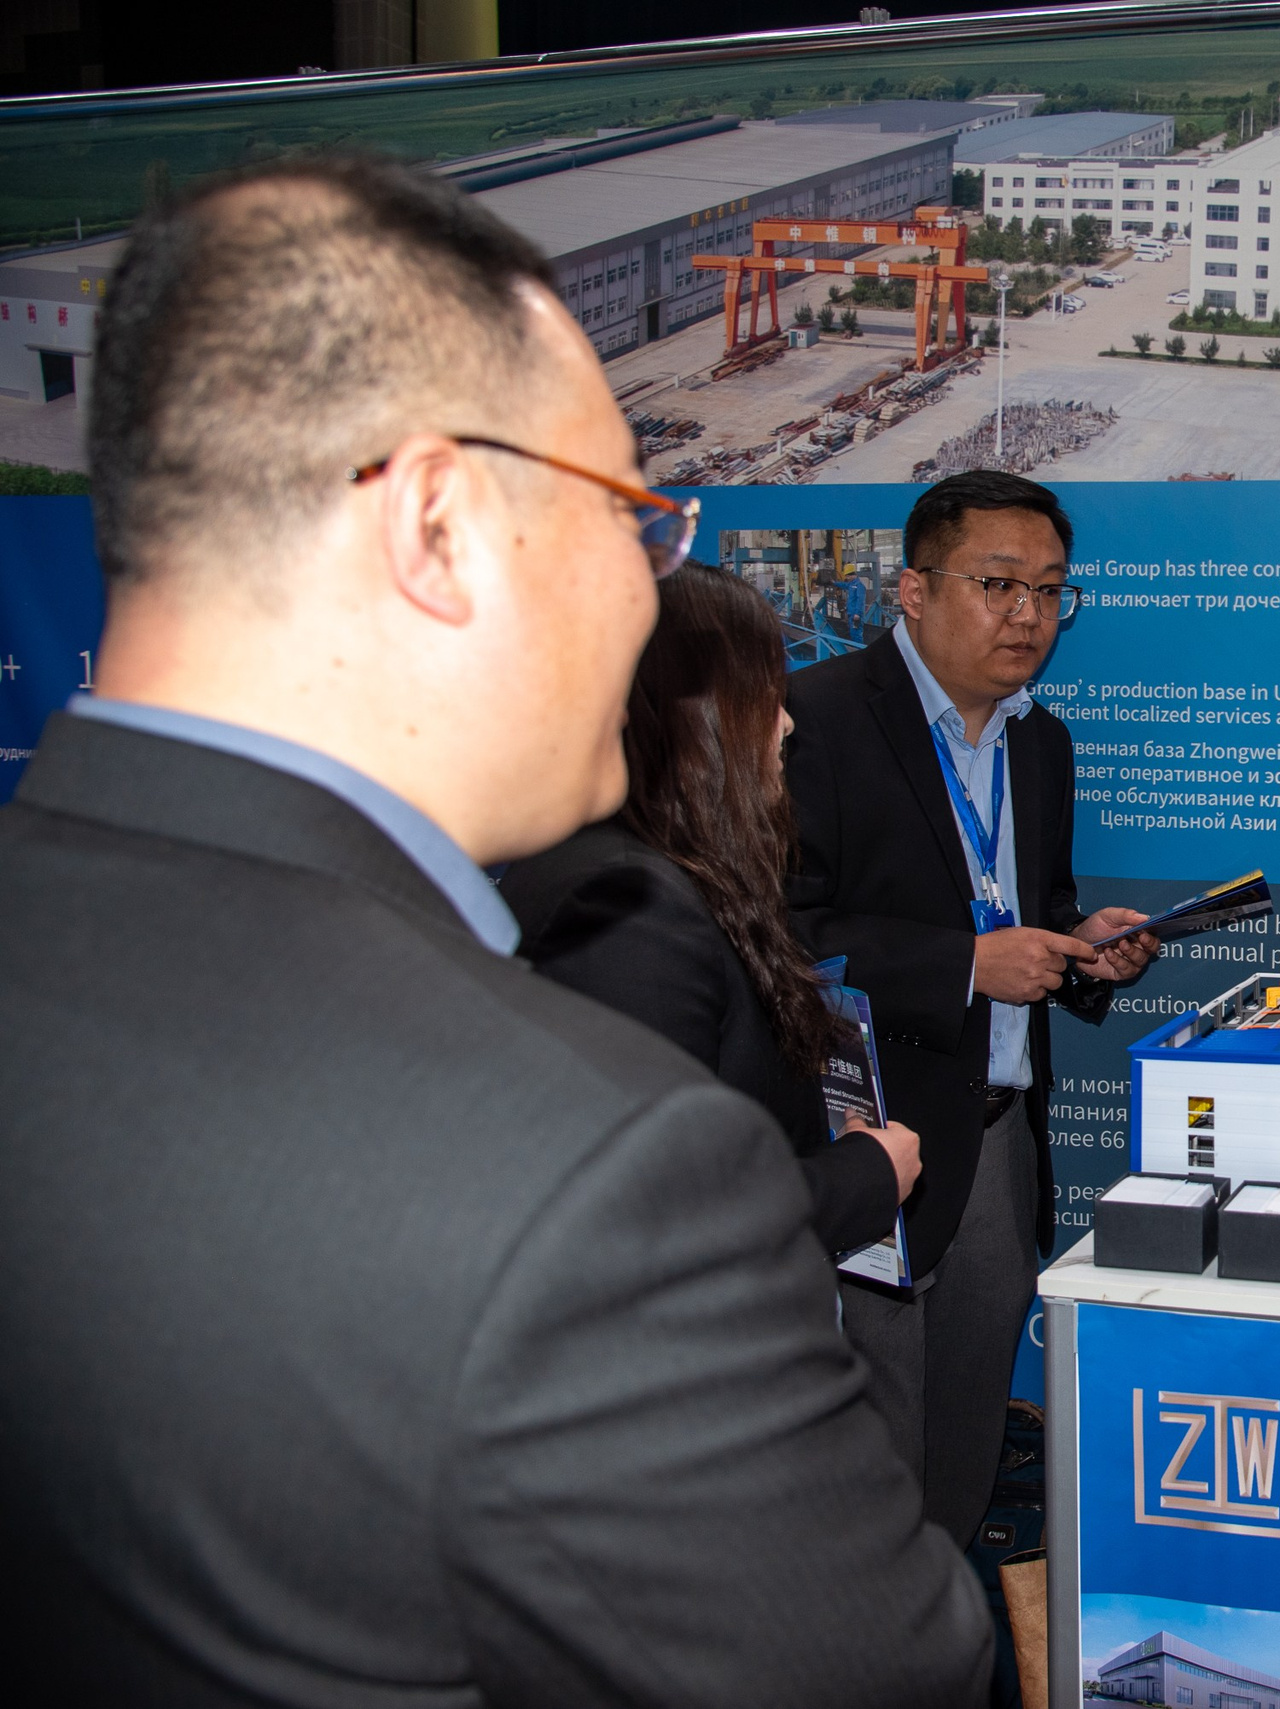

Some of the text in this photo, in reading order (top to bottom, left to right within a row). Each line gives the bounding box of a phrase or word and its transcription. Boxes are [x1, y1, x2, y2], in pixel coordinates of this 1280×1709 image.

[1066, 560, 1101, 578] wei
[1105, 560, 1161, 581] Group
[1165, 559, 1196, 577] has
[1200, 559, 1249, 577] three
[1080, 590, 1097, 607] ei
[1101, 594, 1191, 609] включает
[1195, 594, 1229, 612] три
[1101, 681, 1198, 701] production
[1202, 682, 1246, 700] base
[1251, 683, 1269, 701] in
[1048, 703, 1109, 721] fficient
[1114, 704, 1191, 723] localized
[1195, 707, 1271, 724] services
[1073, 742, 1139, 757] венная
[1143, 740, 1185, 759] база
[1075, 765, 1115, 779] вает
[1120, 766, 1243, 785] оперативное
[1248, 770, 1259, 783] и
[1116, 787, 1255, 809] обслуживание
[1100, 809, 1277, 832] Центральной Азии
[1227, 914, 1268, 934] and
[1156, 943, 1183, 959] an
[1190, 943, 1265, 963] annual
[1108, 995, 1200, 1015] xecution
[1062, 1078, 1075, 1092] и
[1047, 1104, 1128, 1122] мпания
[1048, 1130, 1125, 1149] олее 66
